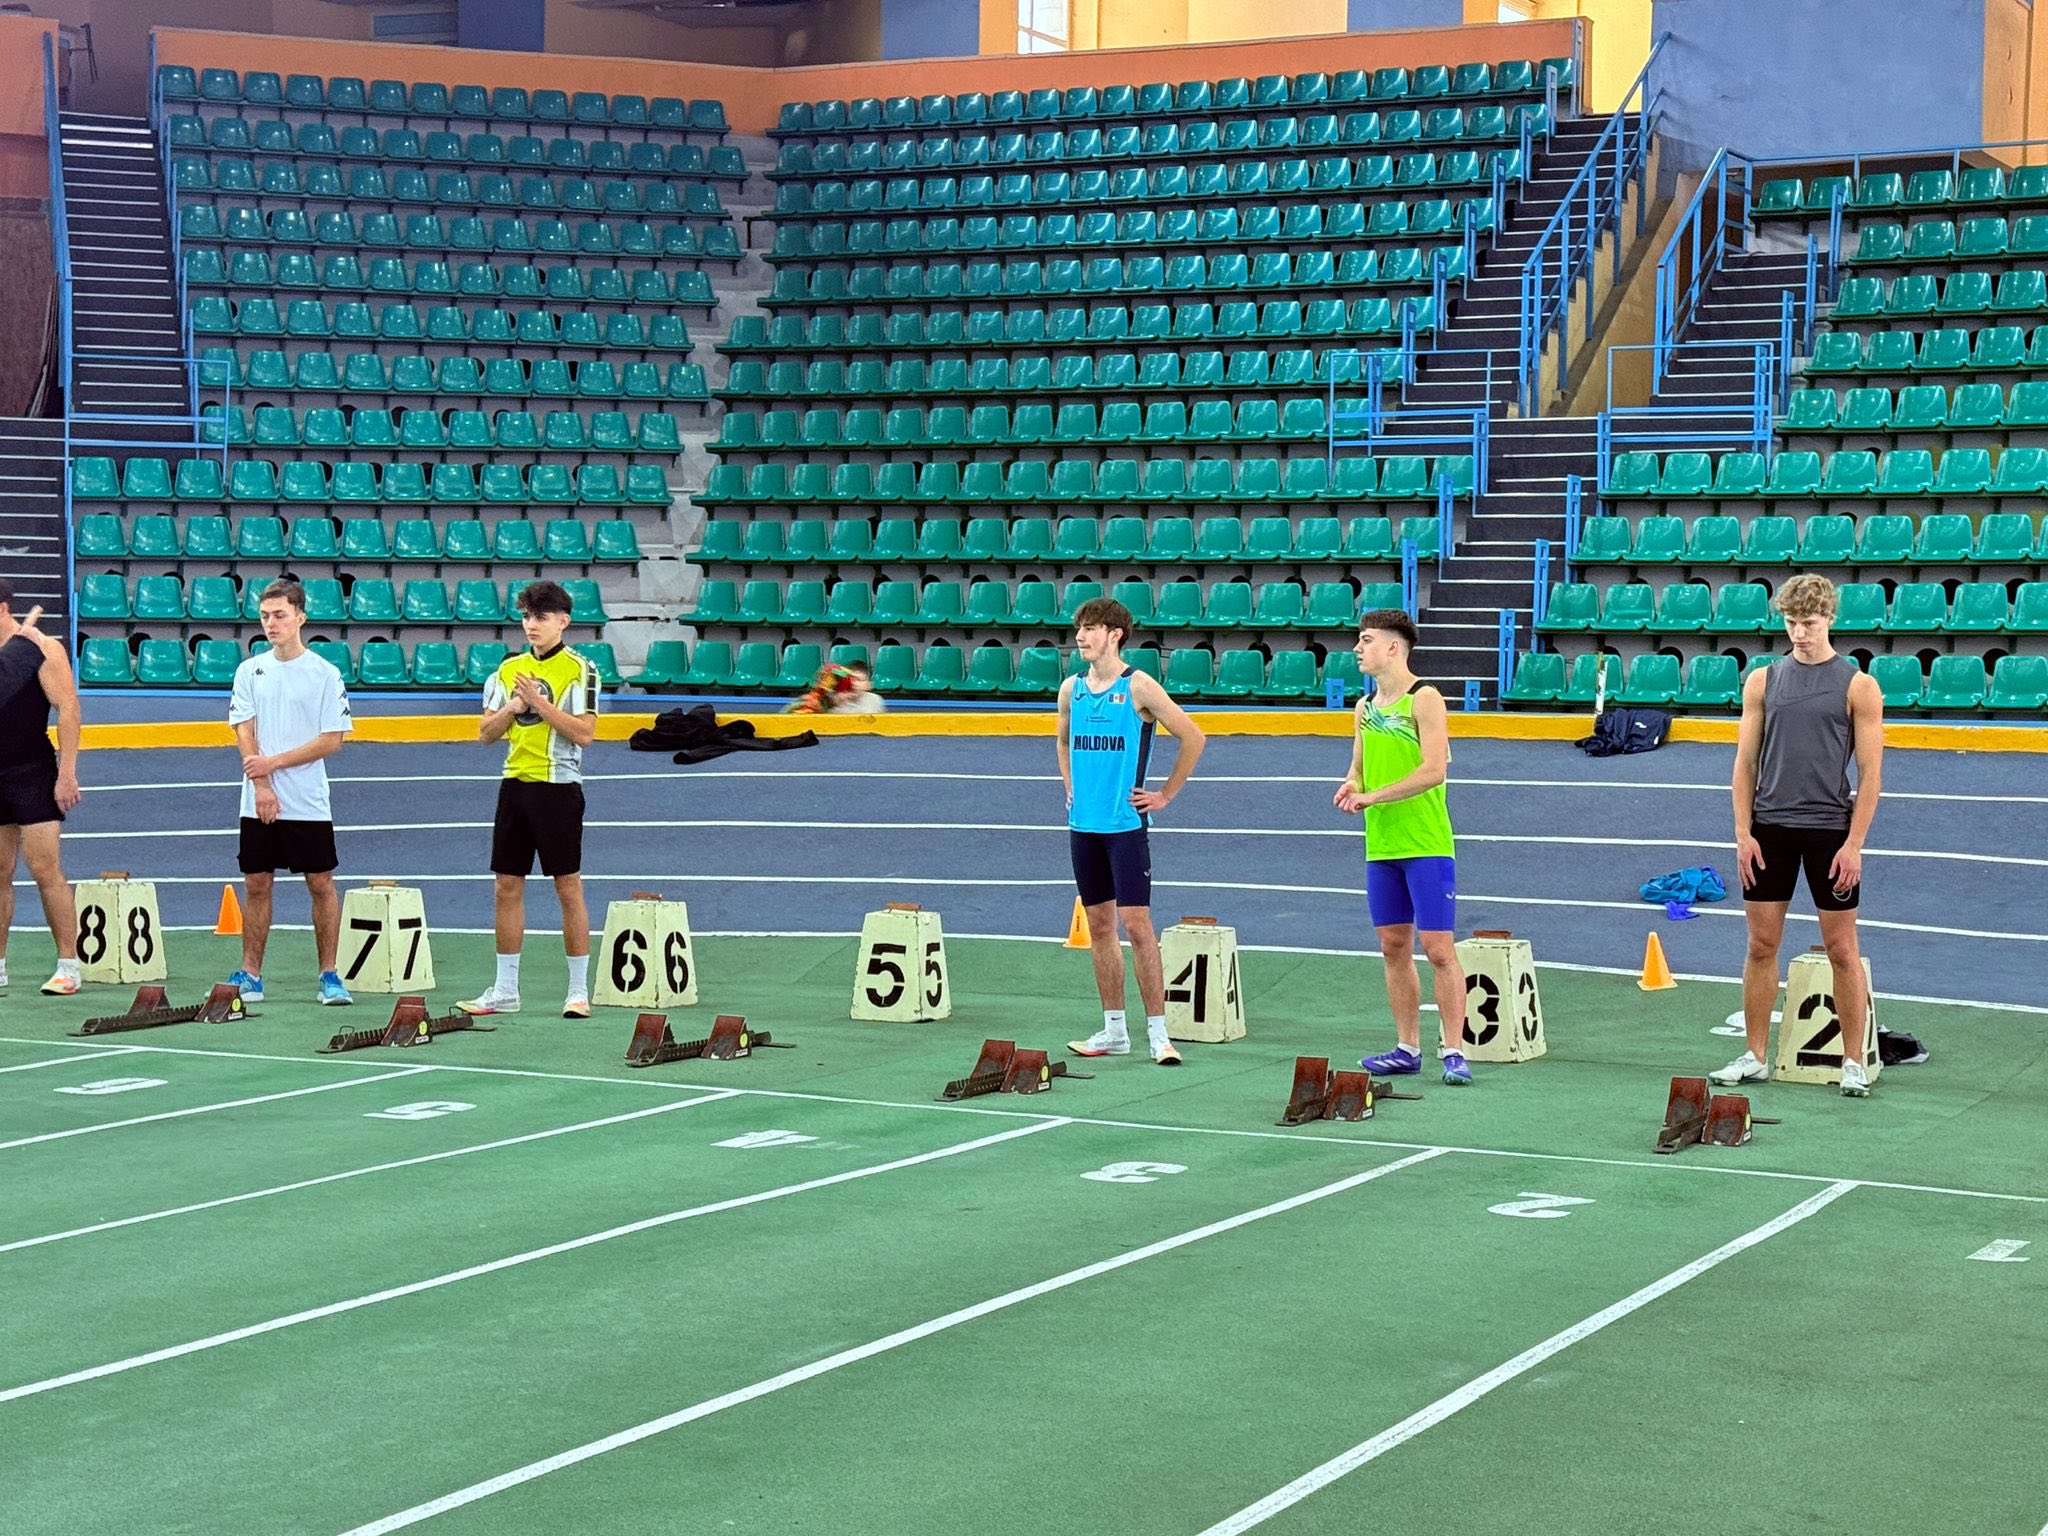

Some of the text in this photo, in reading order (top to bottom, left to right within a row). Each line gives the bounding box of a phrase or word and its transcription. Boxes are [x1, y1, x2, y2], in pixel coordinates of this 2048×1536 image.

[1074, 735, 1125, 751] MOLDOVA
[76, 904, 106, 965] 8
[128, 906, 153, 965] 8
[344, 918, 382, 980] 7
[398, 917, 422, 980] 7
[611, 929, 648, 993] 6
[664, 931, 689, 994] 6
[866, 943, 906, 1008] 5
[925, 942, 942, 1008] 5
[1164, 953, 1208, 1023] 4
[1227, 952, 1239, 1020] 4
[1462, 973, 1500, 1046] 3
[1519, 972, 1538, 1042] 3
[1796, 993, 1844, 1069] 2
[363, 1101, 476, 1120] 5
[1080, 1162, 1188, 1183] 3
[1487, 1192, 1596, 1218] 2
